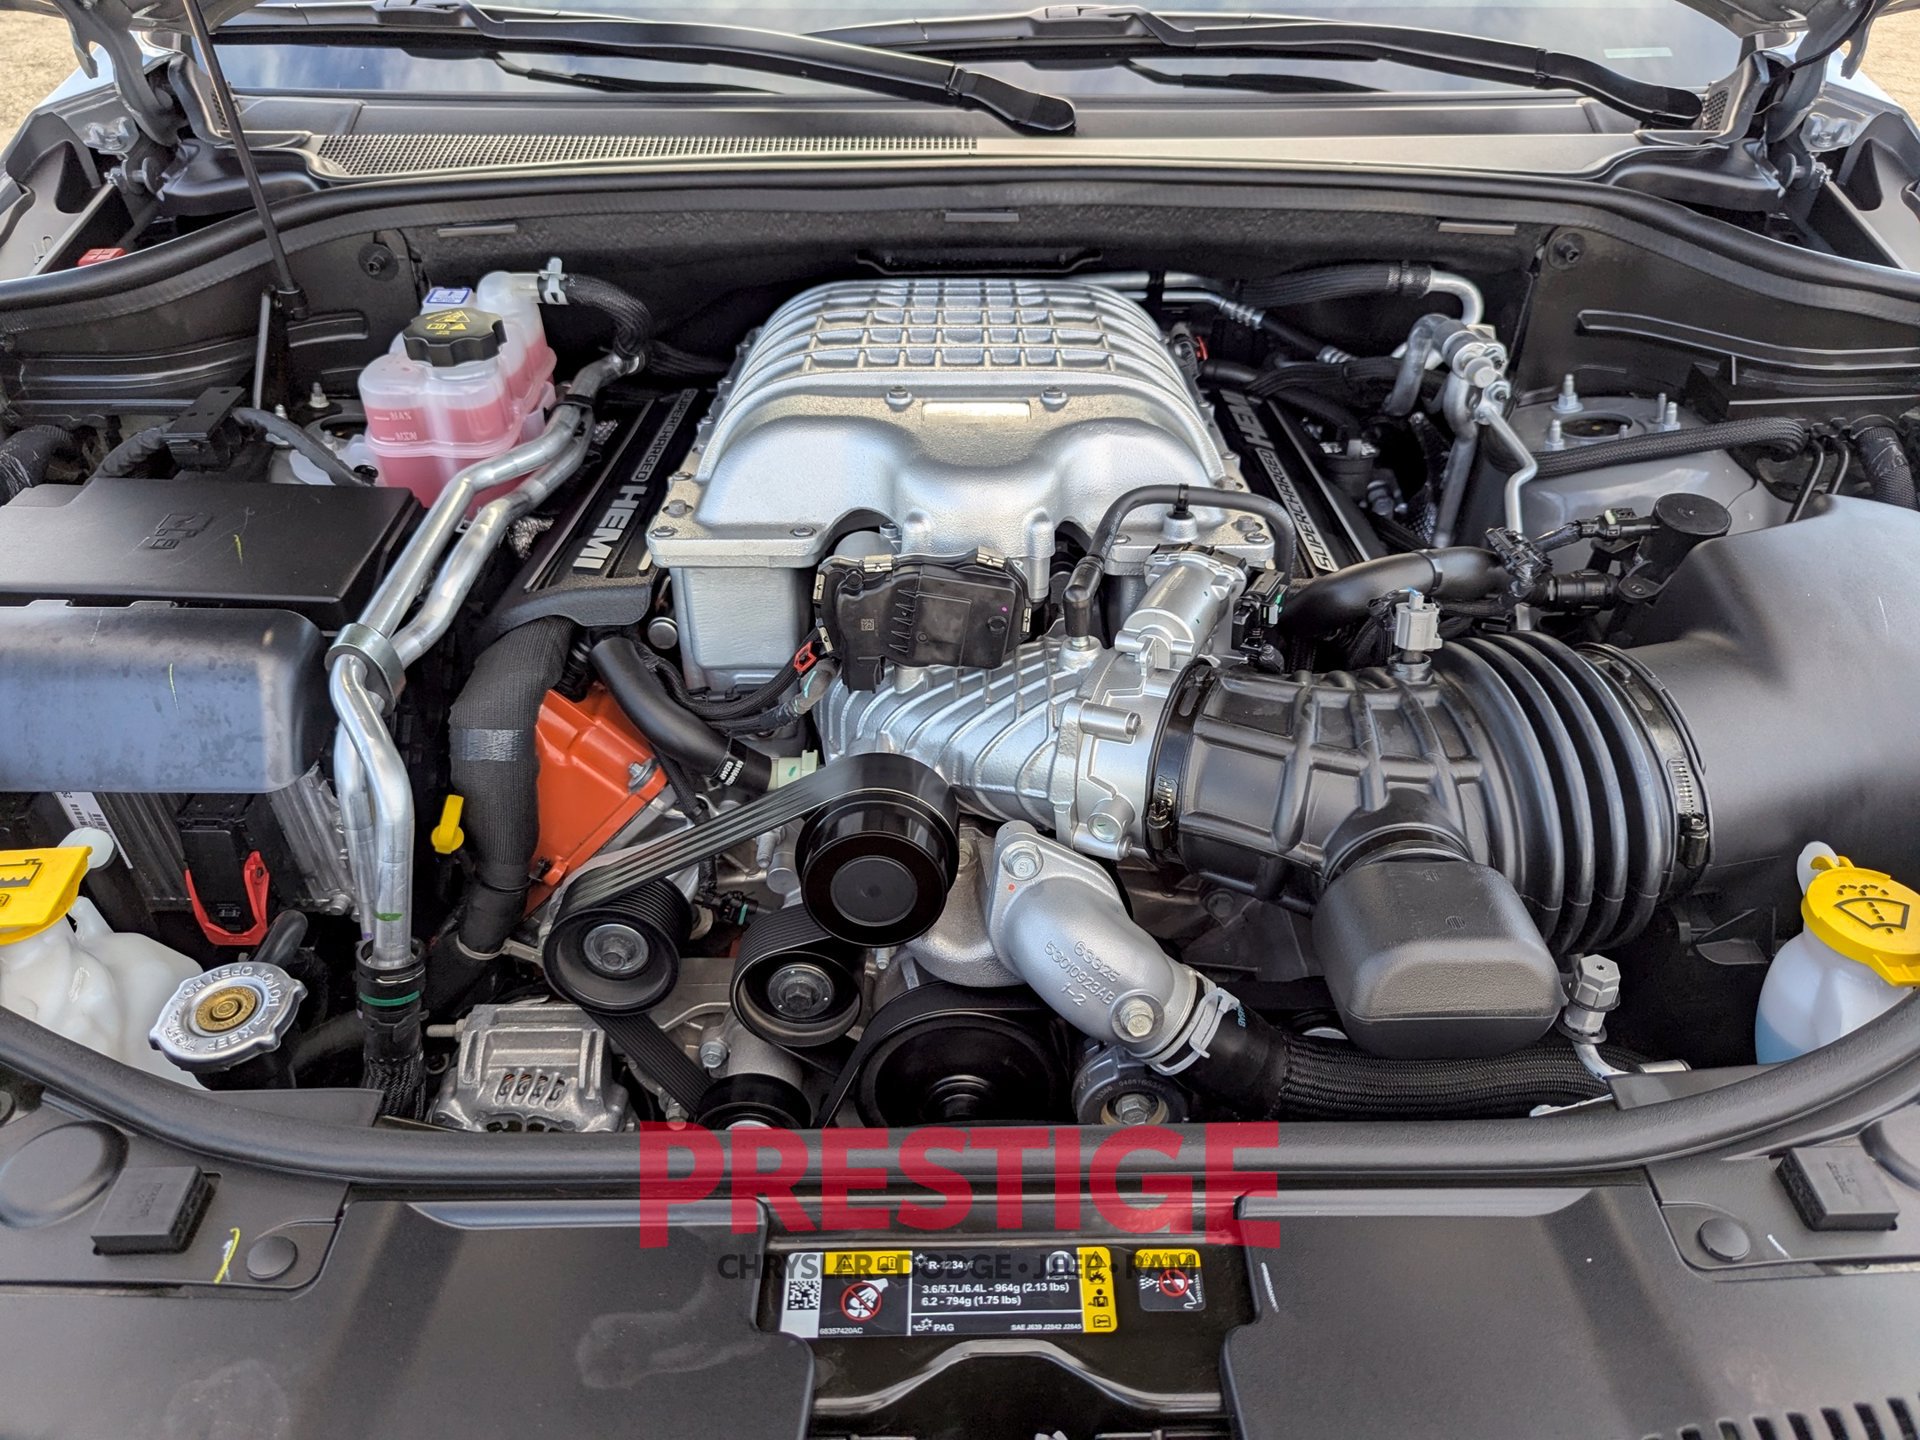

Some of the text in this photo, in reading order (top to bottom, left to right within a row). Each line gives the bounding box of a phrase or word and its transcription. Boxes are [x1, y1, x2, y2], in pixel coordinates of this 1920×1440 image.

[390, 411, 412, 421] MAX
[395, 431, 418, 441] MIN
[573, 389, 697, 569] SUPERCHARGED HEMI
[1259, 449, 1336, 571] SUPERCHARGED
[1074, 940, 1121, 982] 63325
[210, 965, 254, 983] OPEN
[1044, 940, 1116, 1006] 53010923AB
[1061, 981, 1087, 1006] 1-2
[208, 1026, 255, 1051] KEEP
[921, 1283, 987, 1294] 3.6/5.7L/6.4L
[994, 1283, 1020, 1294] 964g
[1021, 1283, 1048, 1294] (2.13
[1049, 1282, 1070, 1293] lbs)
[921, 1297, 938, 1306] 6.2
[945, 1296, 972, 1307] 794g
[973, 1295, 999, 1307] (1.75
[1001, 1295, 1022, 1306] lbs)
[933, 1323, 955, 1331] PAG
